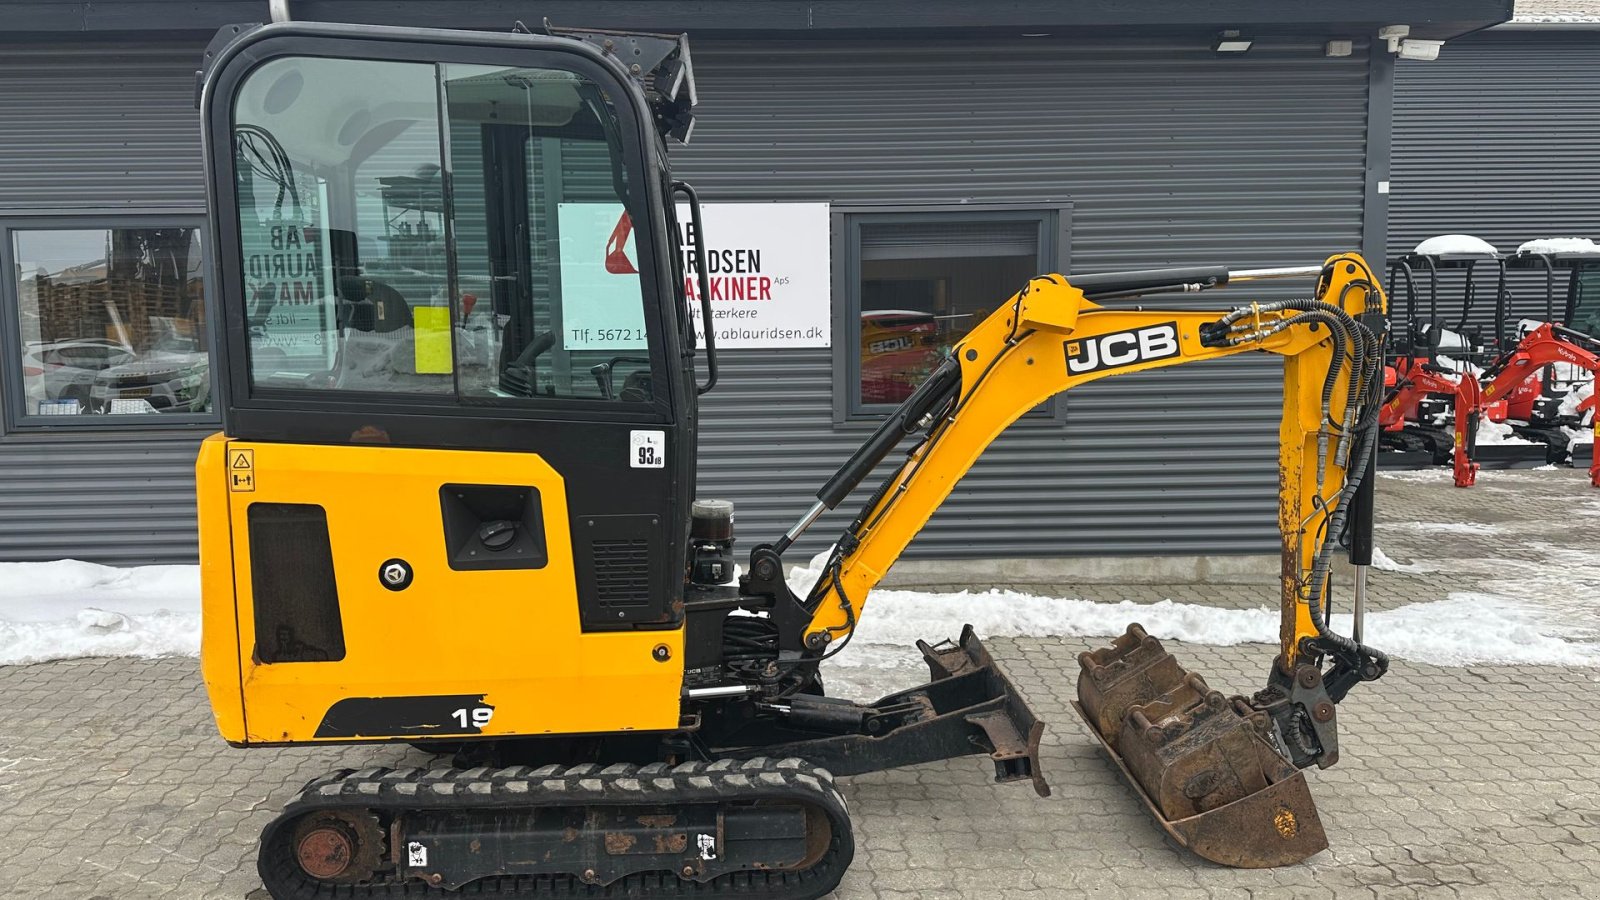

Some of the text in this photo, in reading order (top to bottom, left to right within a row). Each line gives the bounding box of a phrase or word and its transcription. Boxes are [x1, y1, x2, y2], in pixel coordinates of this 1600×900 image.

[684, 276, 790, 301] AKINER ApS
[711, 307, 758, 319] tærkere
[572, 328, 594, 344] Tlf.
[598, 329, 631, 341] 5672
[1068, 324, 1178, 372] JCB
[638, 446, 662, 465] 93 dB
[451, 707, 494, 728] 19
